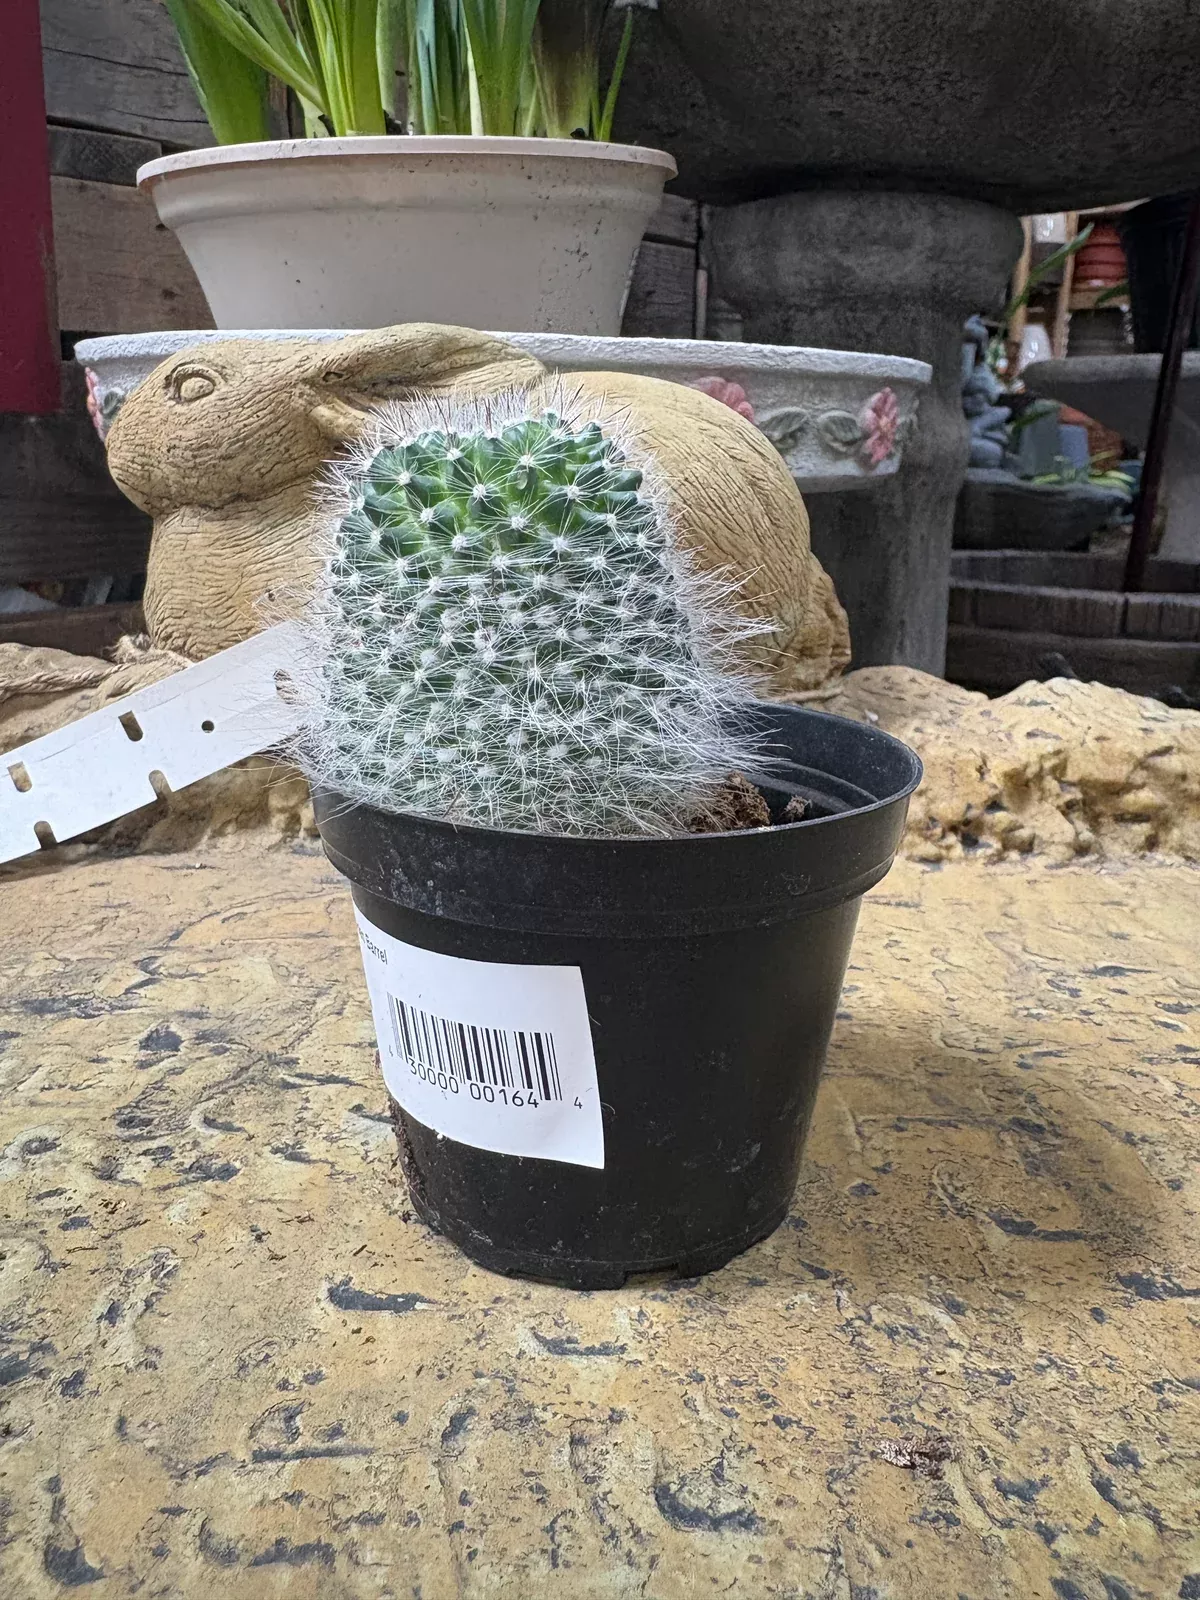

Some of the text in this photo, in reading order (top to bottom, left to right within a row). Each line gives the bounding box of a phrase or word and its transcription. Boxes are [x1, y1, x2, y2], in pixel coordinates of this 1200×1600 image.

[408, 1058, 459, 1094] 30000
[469, 1082, 539, 1109] 00164
[573, 1096, 583, 1110] 4
